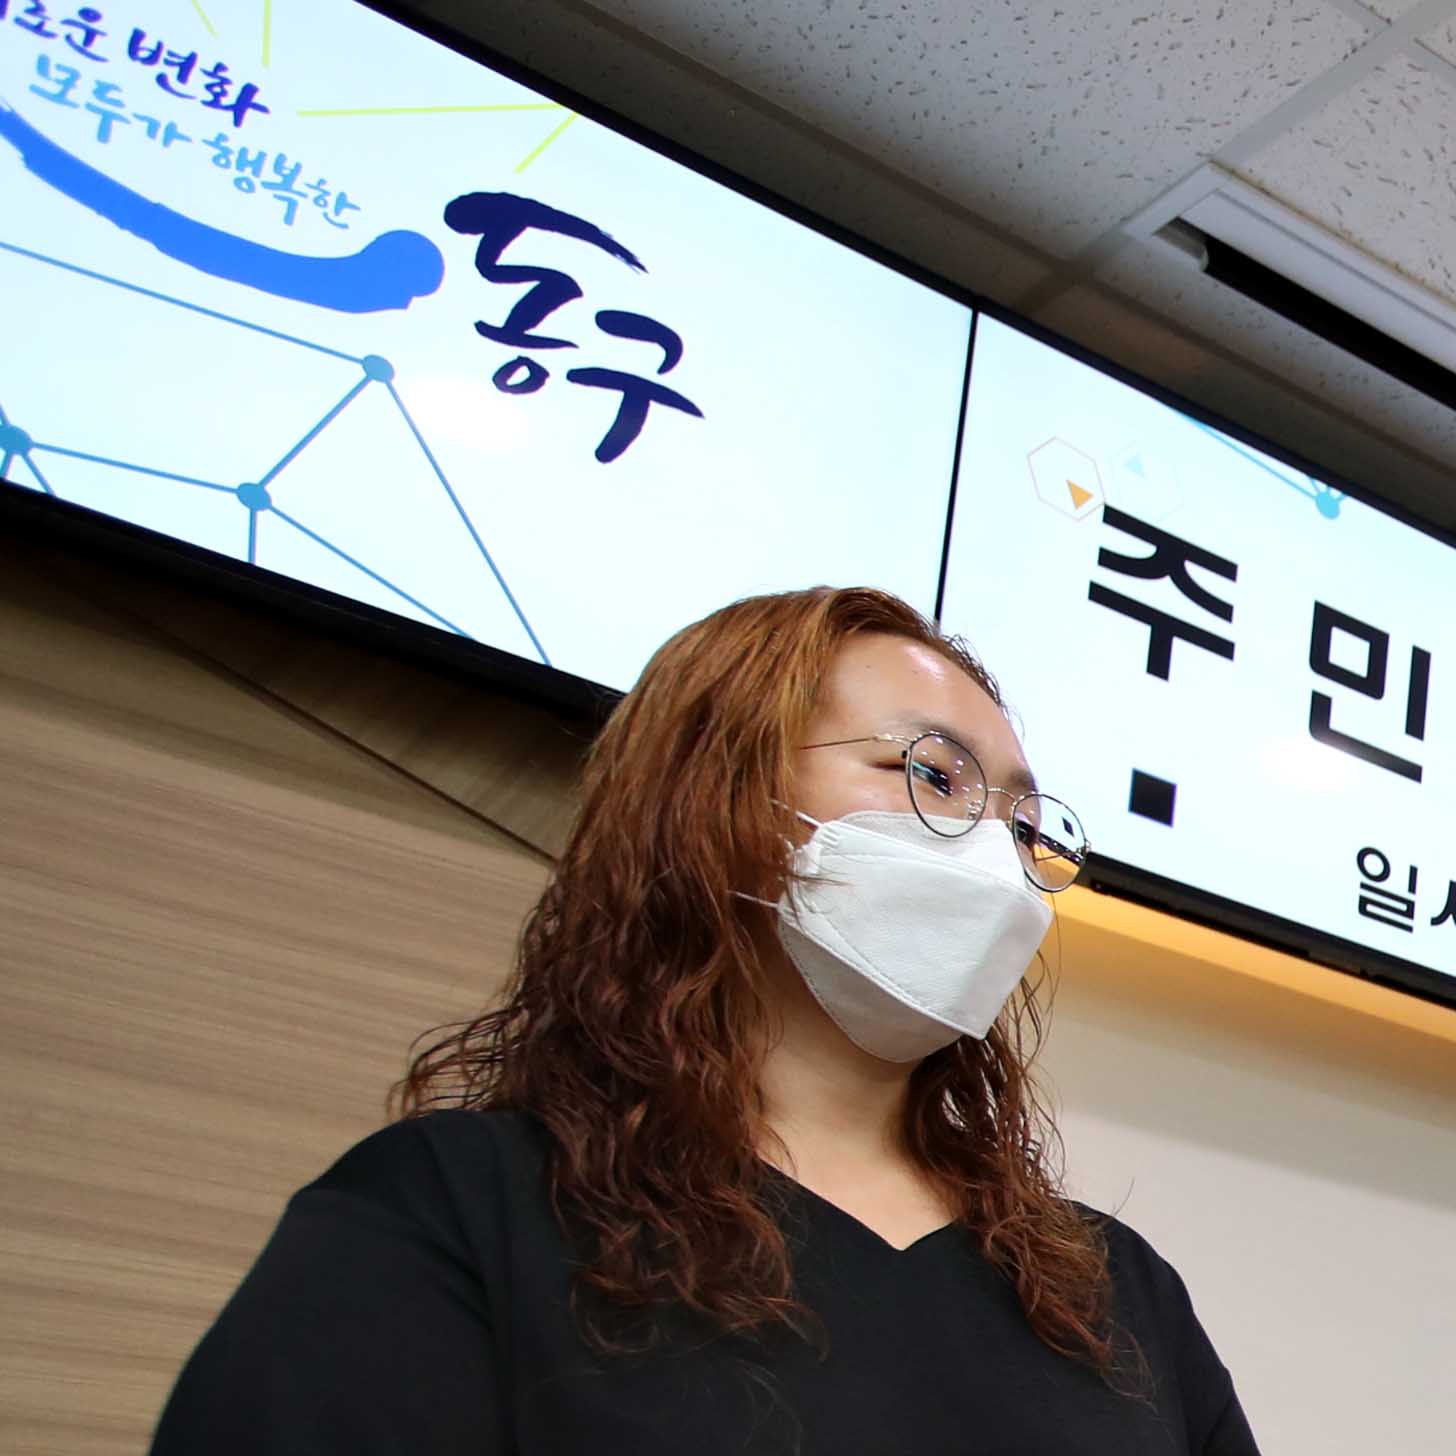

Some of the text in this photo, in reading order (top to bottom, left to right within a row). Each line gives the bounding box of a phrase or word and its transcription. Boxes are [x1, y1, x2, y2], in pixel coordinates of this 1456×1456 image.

[0, 0, 270, 128] 로운 변화
[29, 53, 361, 228] 모두가 행복한
[443, 191, 704, 464] 동구
